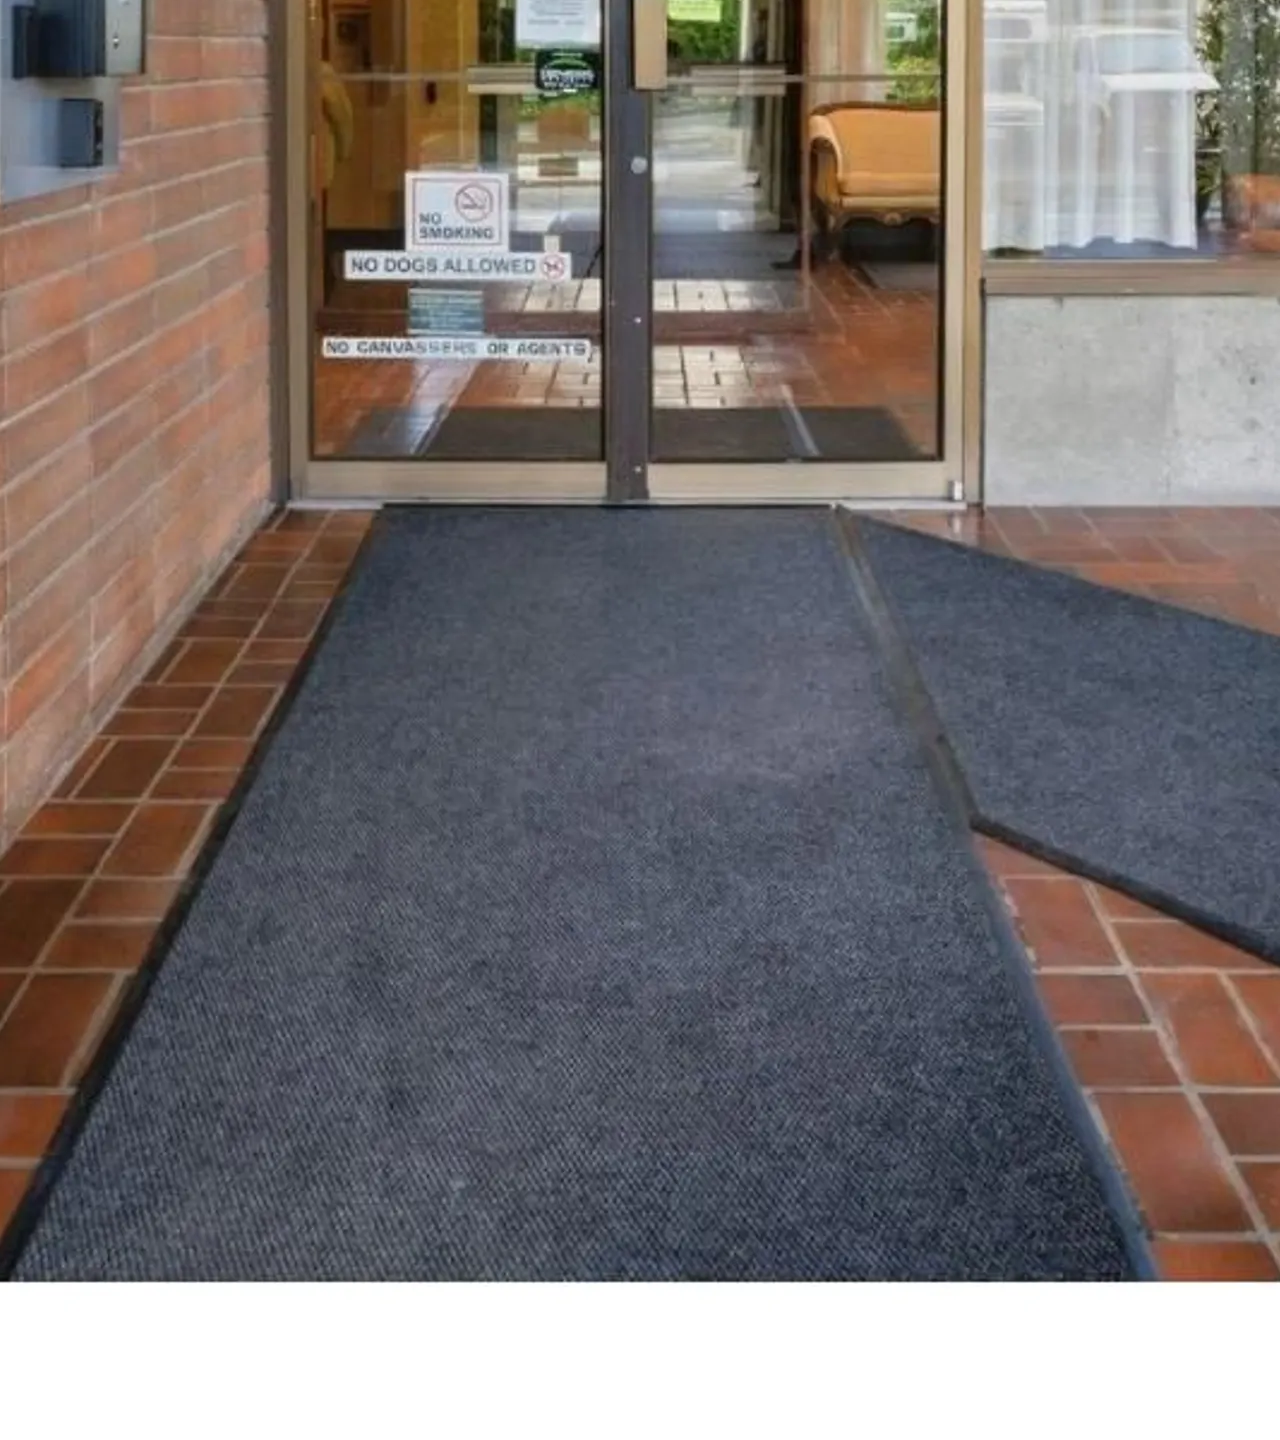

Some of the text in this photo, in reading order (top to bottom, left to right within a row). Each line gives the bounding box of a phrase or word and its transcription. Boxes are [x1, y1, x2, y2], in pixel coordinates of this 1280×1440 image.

[418, 211, 442, 226] NO
[418, 226, 495, 240] SMOKING
[351, 257, 536, 273] NO DOGS ALLOWED
[325, 340, 350, 355] NO
[486, 342, 510, 356] OR
[517, 342, 587, 357] AGENTS
